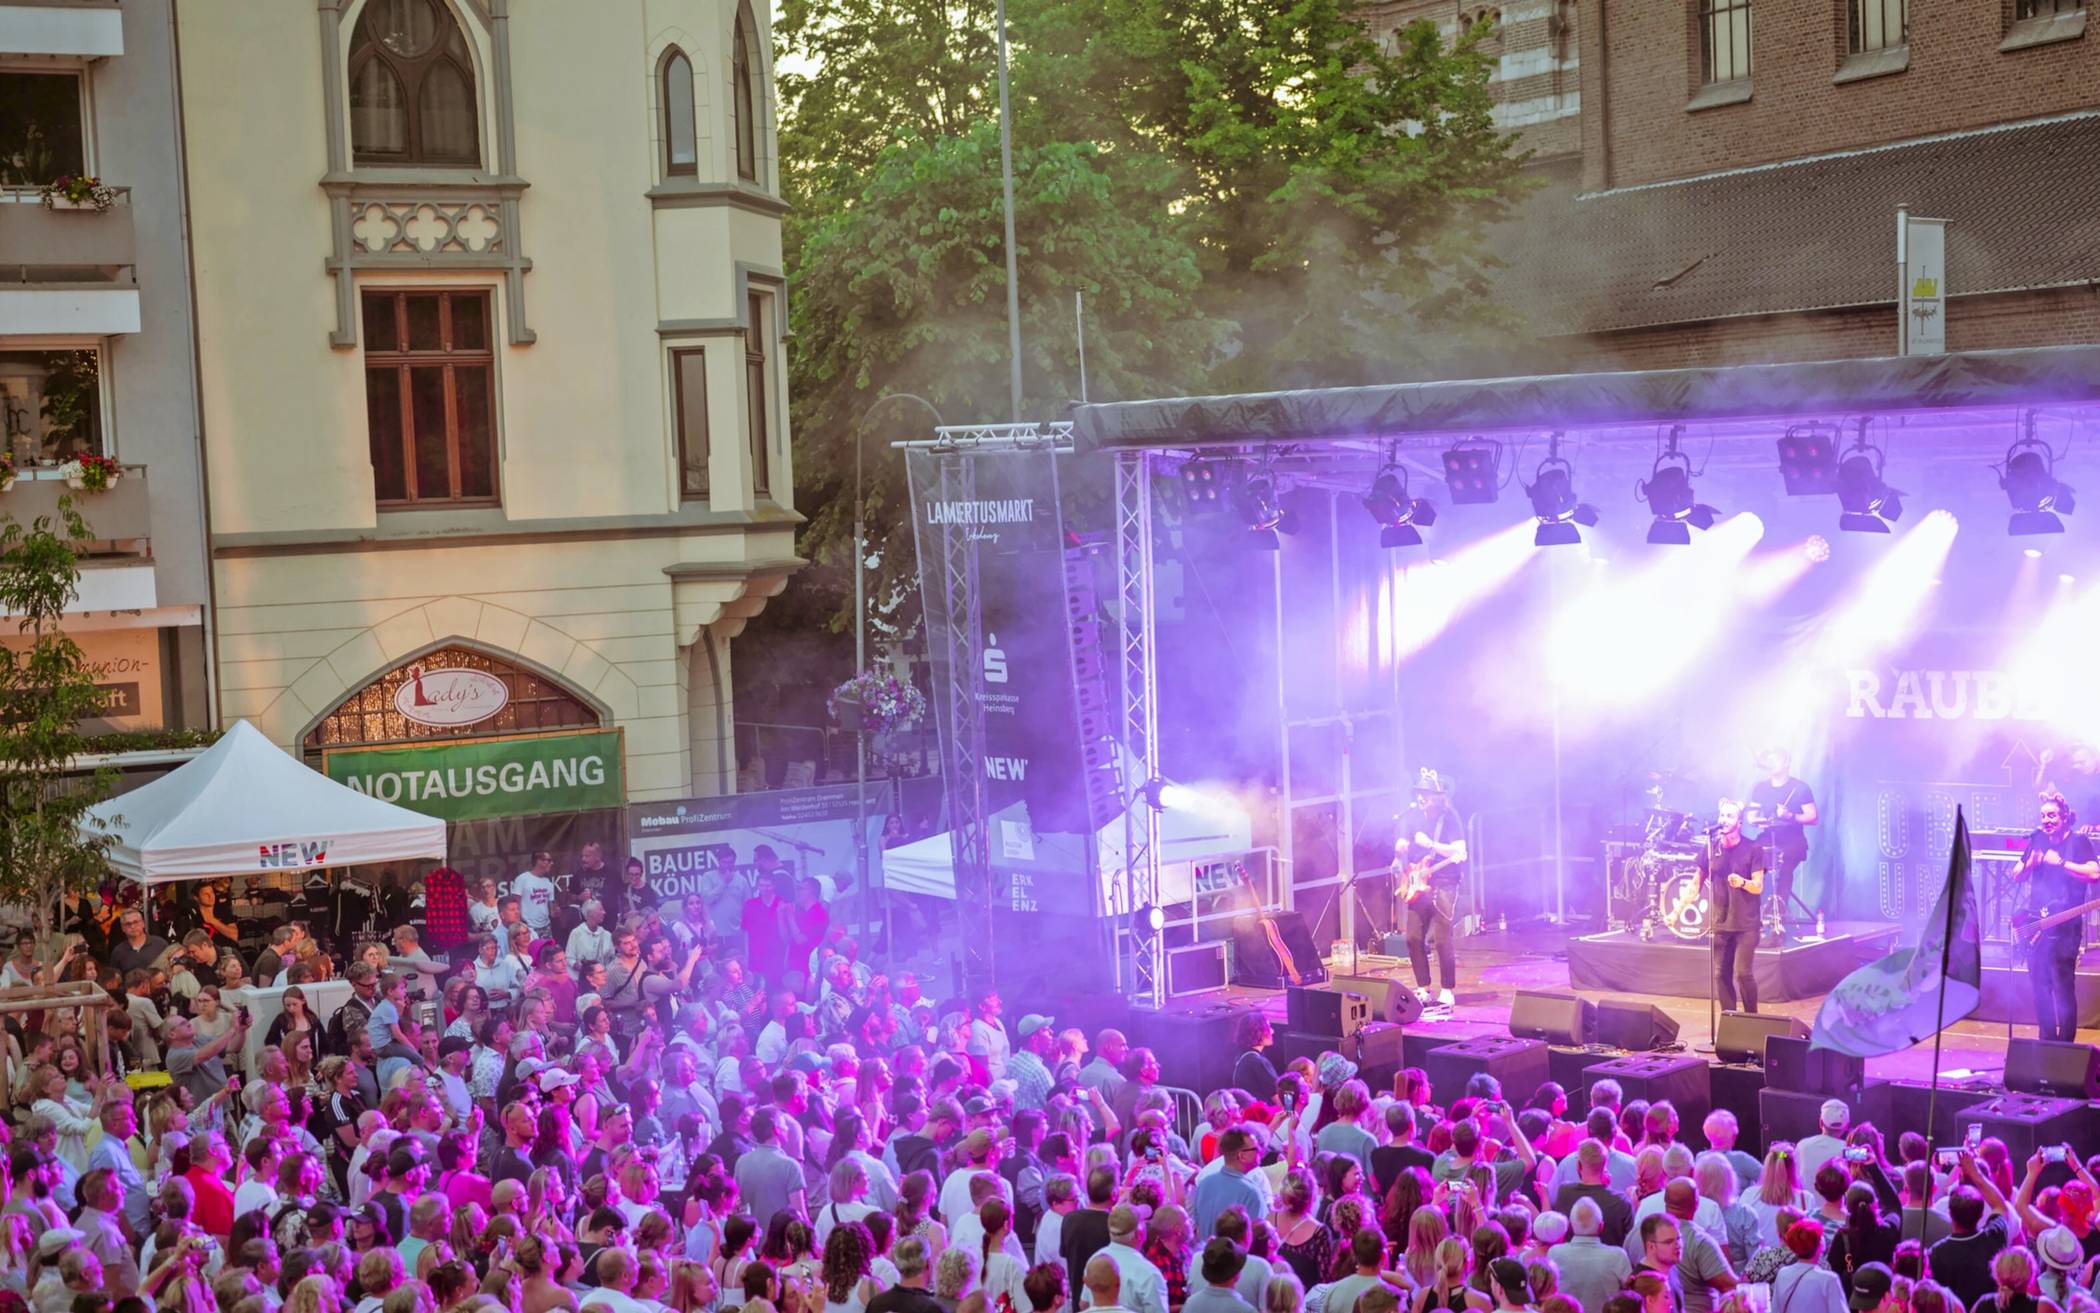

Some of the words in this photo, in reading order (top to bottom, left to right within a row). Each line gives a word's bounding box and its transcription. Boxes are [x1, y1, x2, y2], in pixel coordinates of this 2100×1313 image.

[926, 498, 1034, 525] LAMERTUSMARKT
[347, 754, 605, 802] NOTAUSGANG
[984, 756, 1025, 781] NEW
[640, 816, 680, 828] Mobau
[259, 841, 327, 868] NEW
[1012, 900, 1039, 912] ENZ
